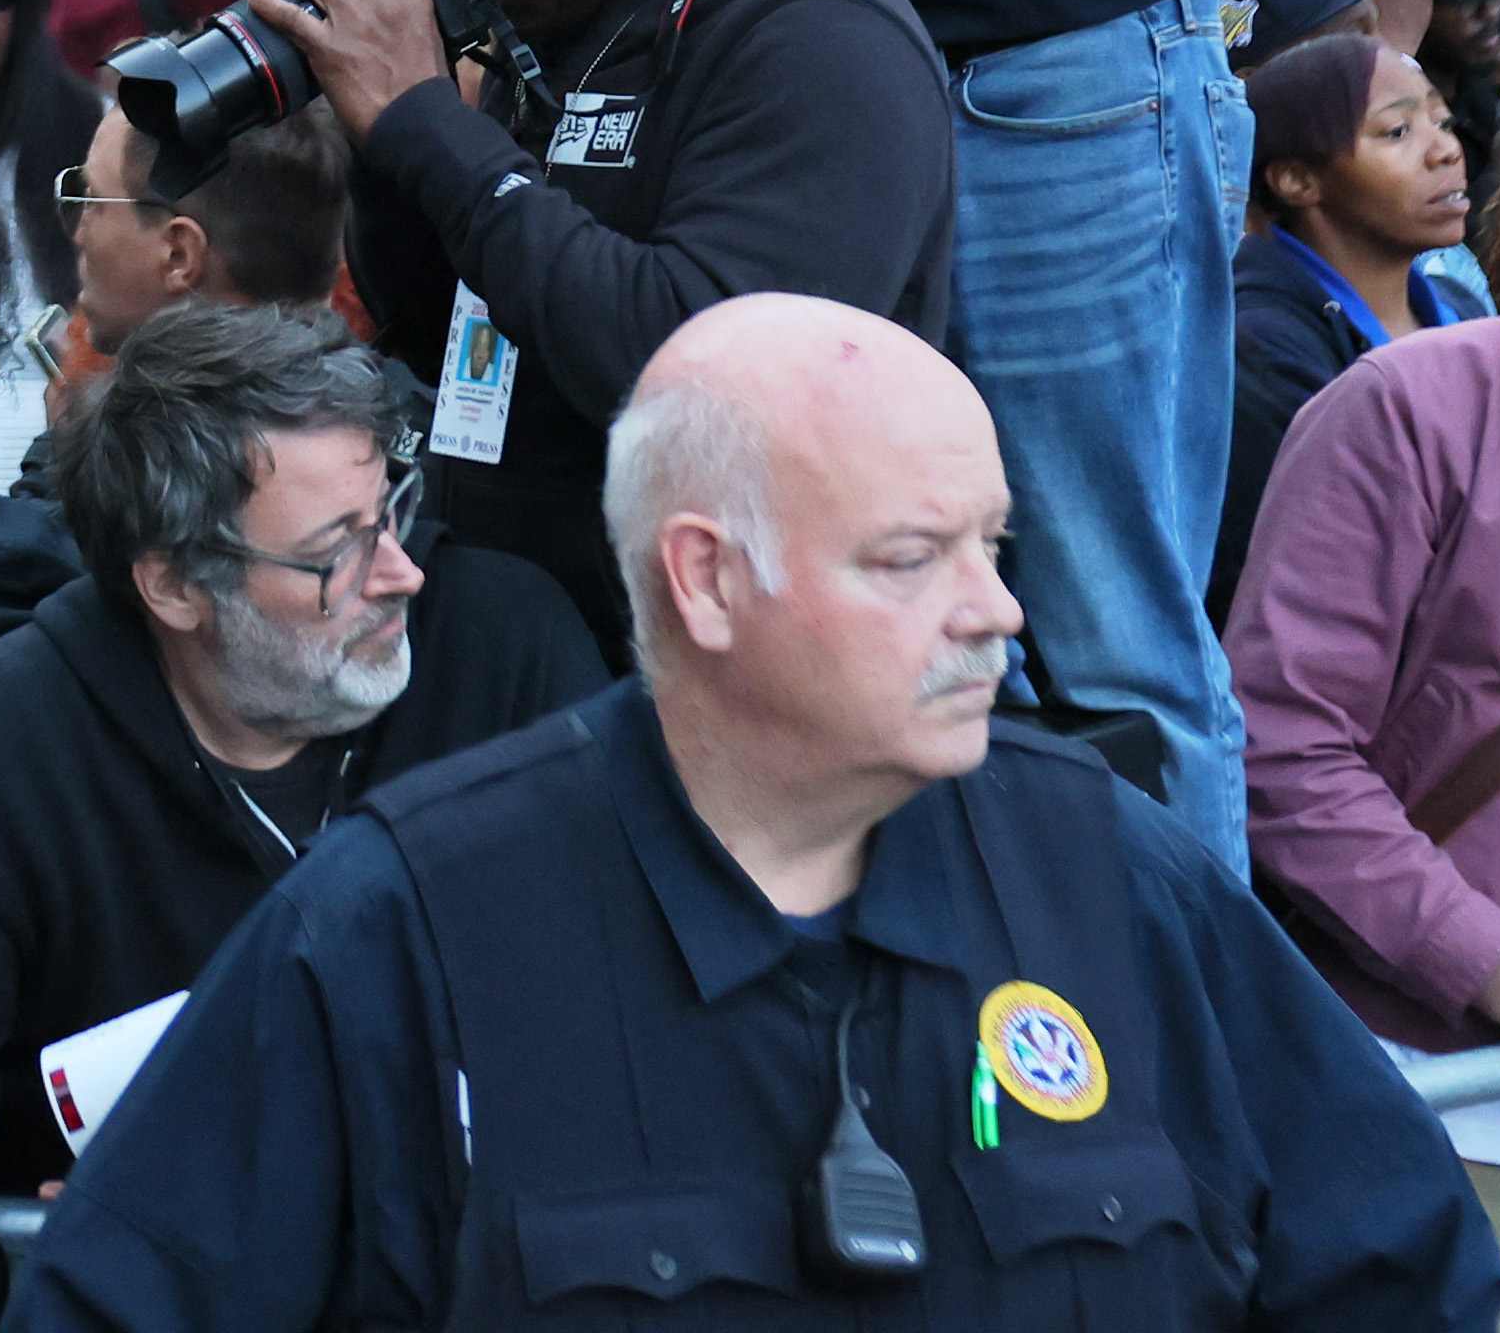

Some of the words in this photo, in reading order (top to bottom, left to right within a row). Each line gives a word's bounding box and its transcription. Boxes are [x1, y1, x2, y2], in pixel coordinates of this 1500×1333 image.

[599, 110, 636, 130] NEW
[592, 130, 628, 151] ERA
[433, 433, 458, 447] PRESS
[474, 439, 499, 455] PRESS
